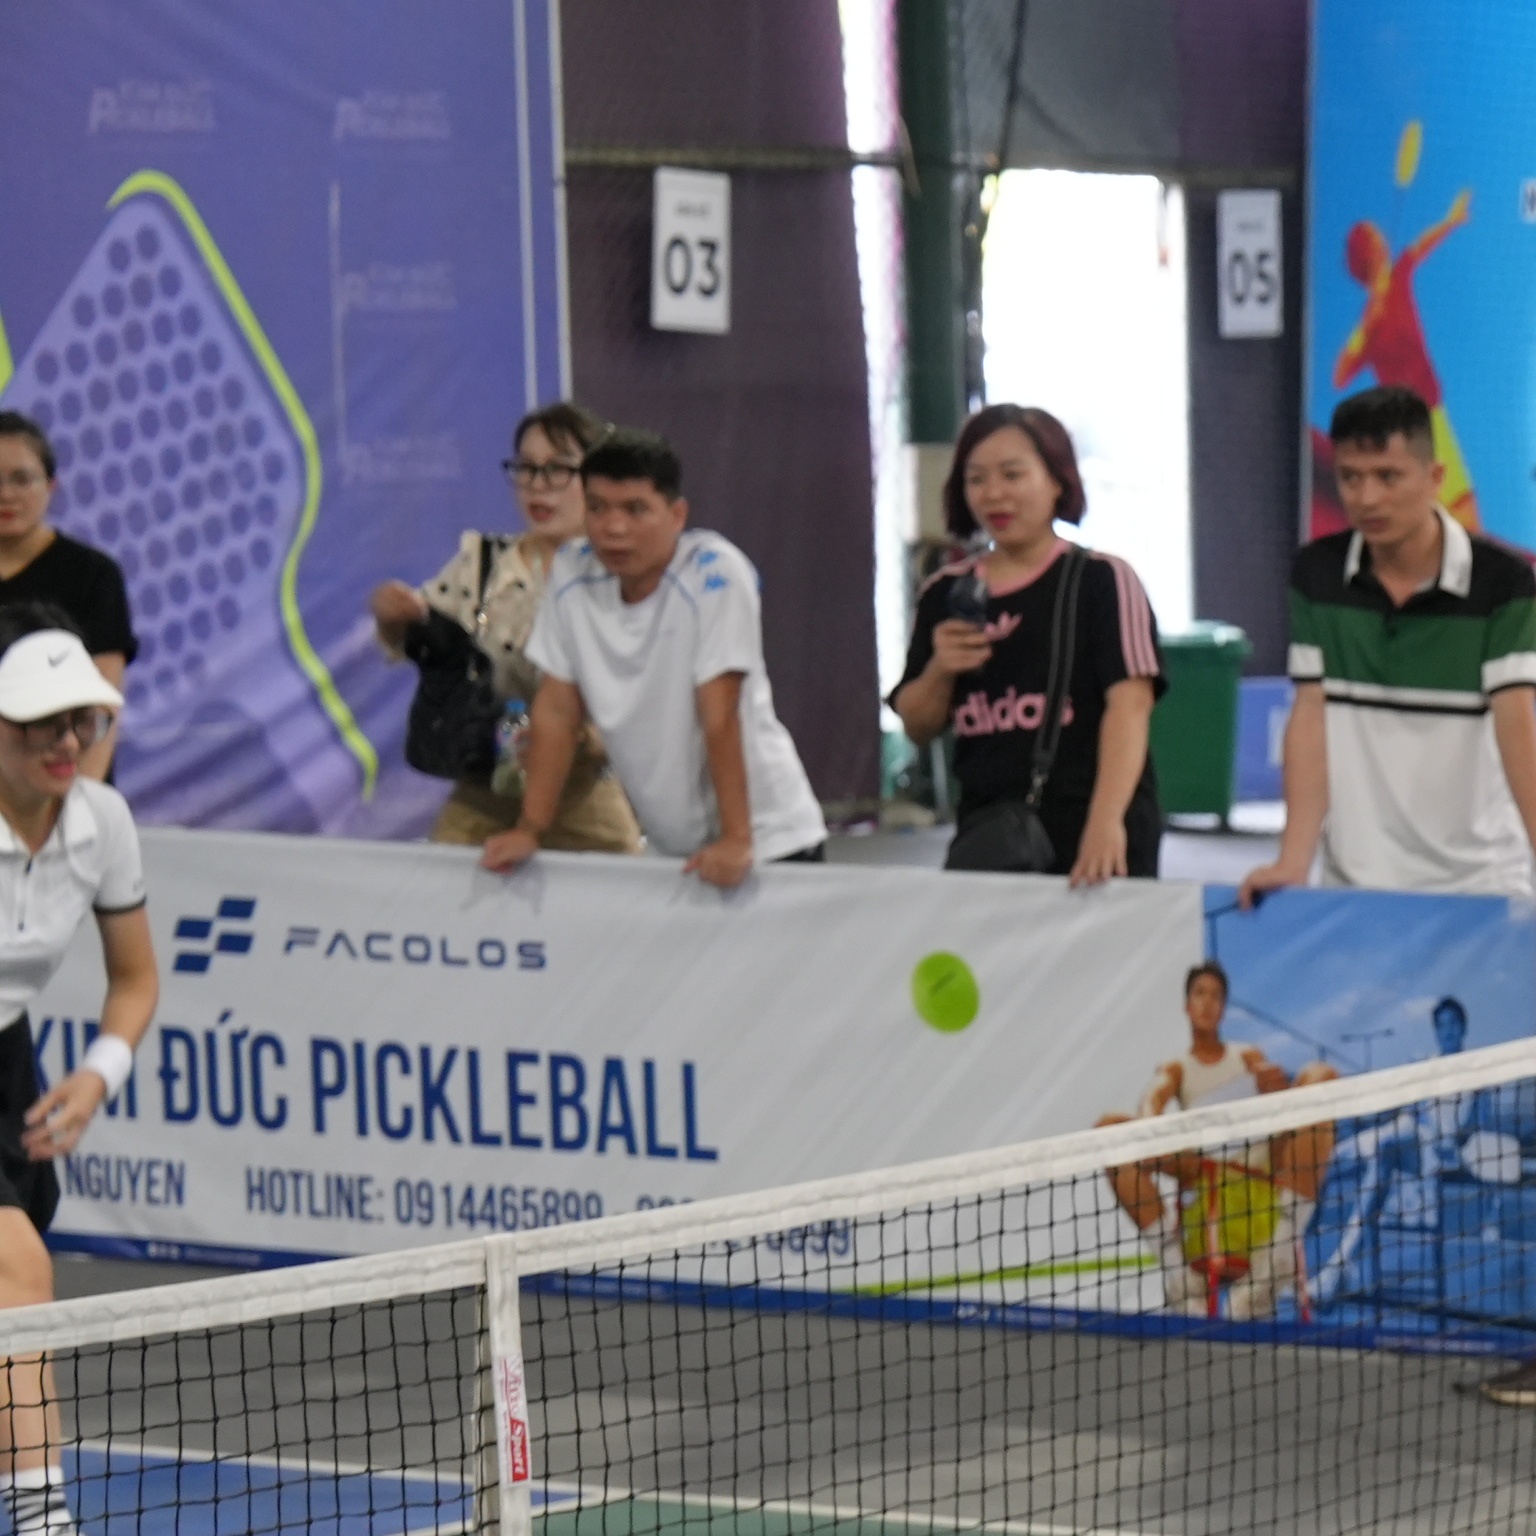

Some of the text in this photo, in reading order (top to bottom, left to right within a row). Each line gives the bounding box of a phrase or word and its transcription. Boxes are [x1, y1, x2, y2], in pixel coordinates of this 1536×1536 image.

[664, 233, 721, 299] 03
[1228, 249, 1280, 306] 05
[283, 926, 547, 970] FACOLOS
[158, 1008, 288, 1132] ĐỨC
[310, 1033, 720, 1164] PICKLEBALL
[246, 1166, 384, 1223] HOTLINE:
[394, 1178, 604, 1230] 0914465899
